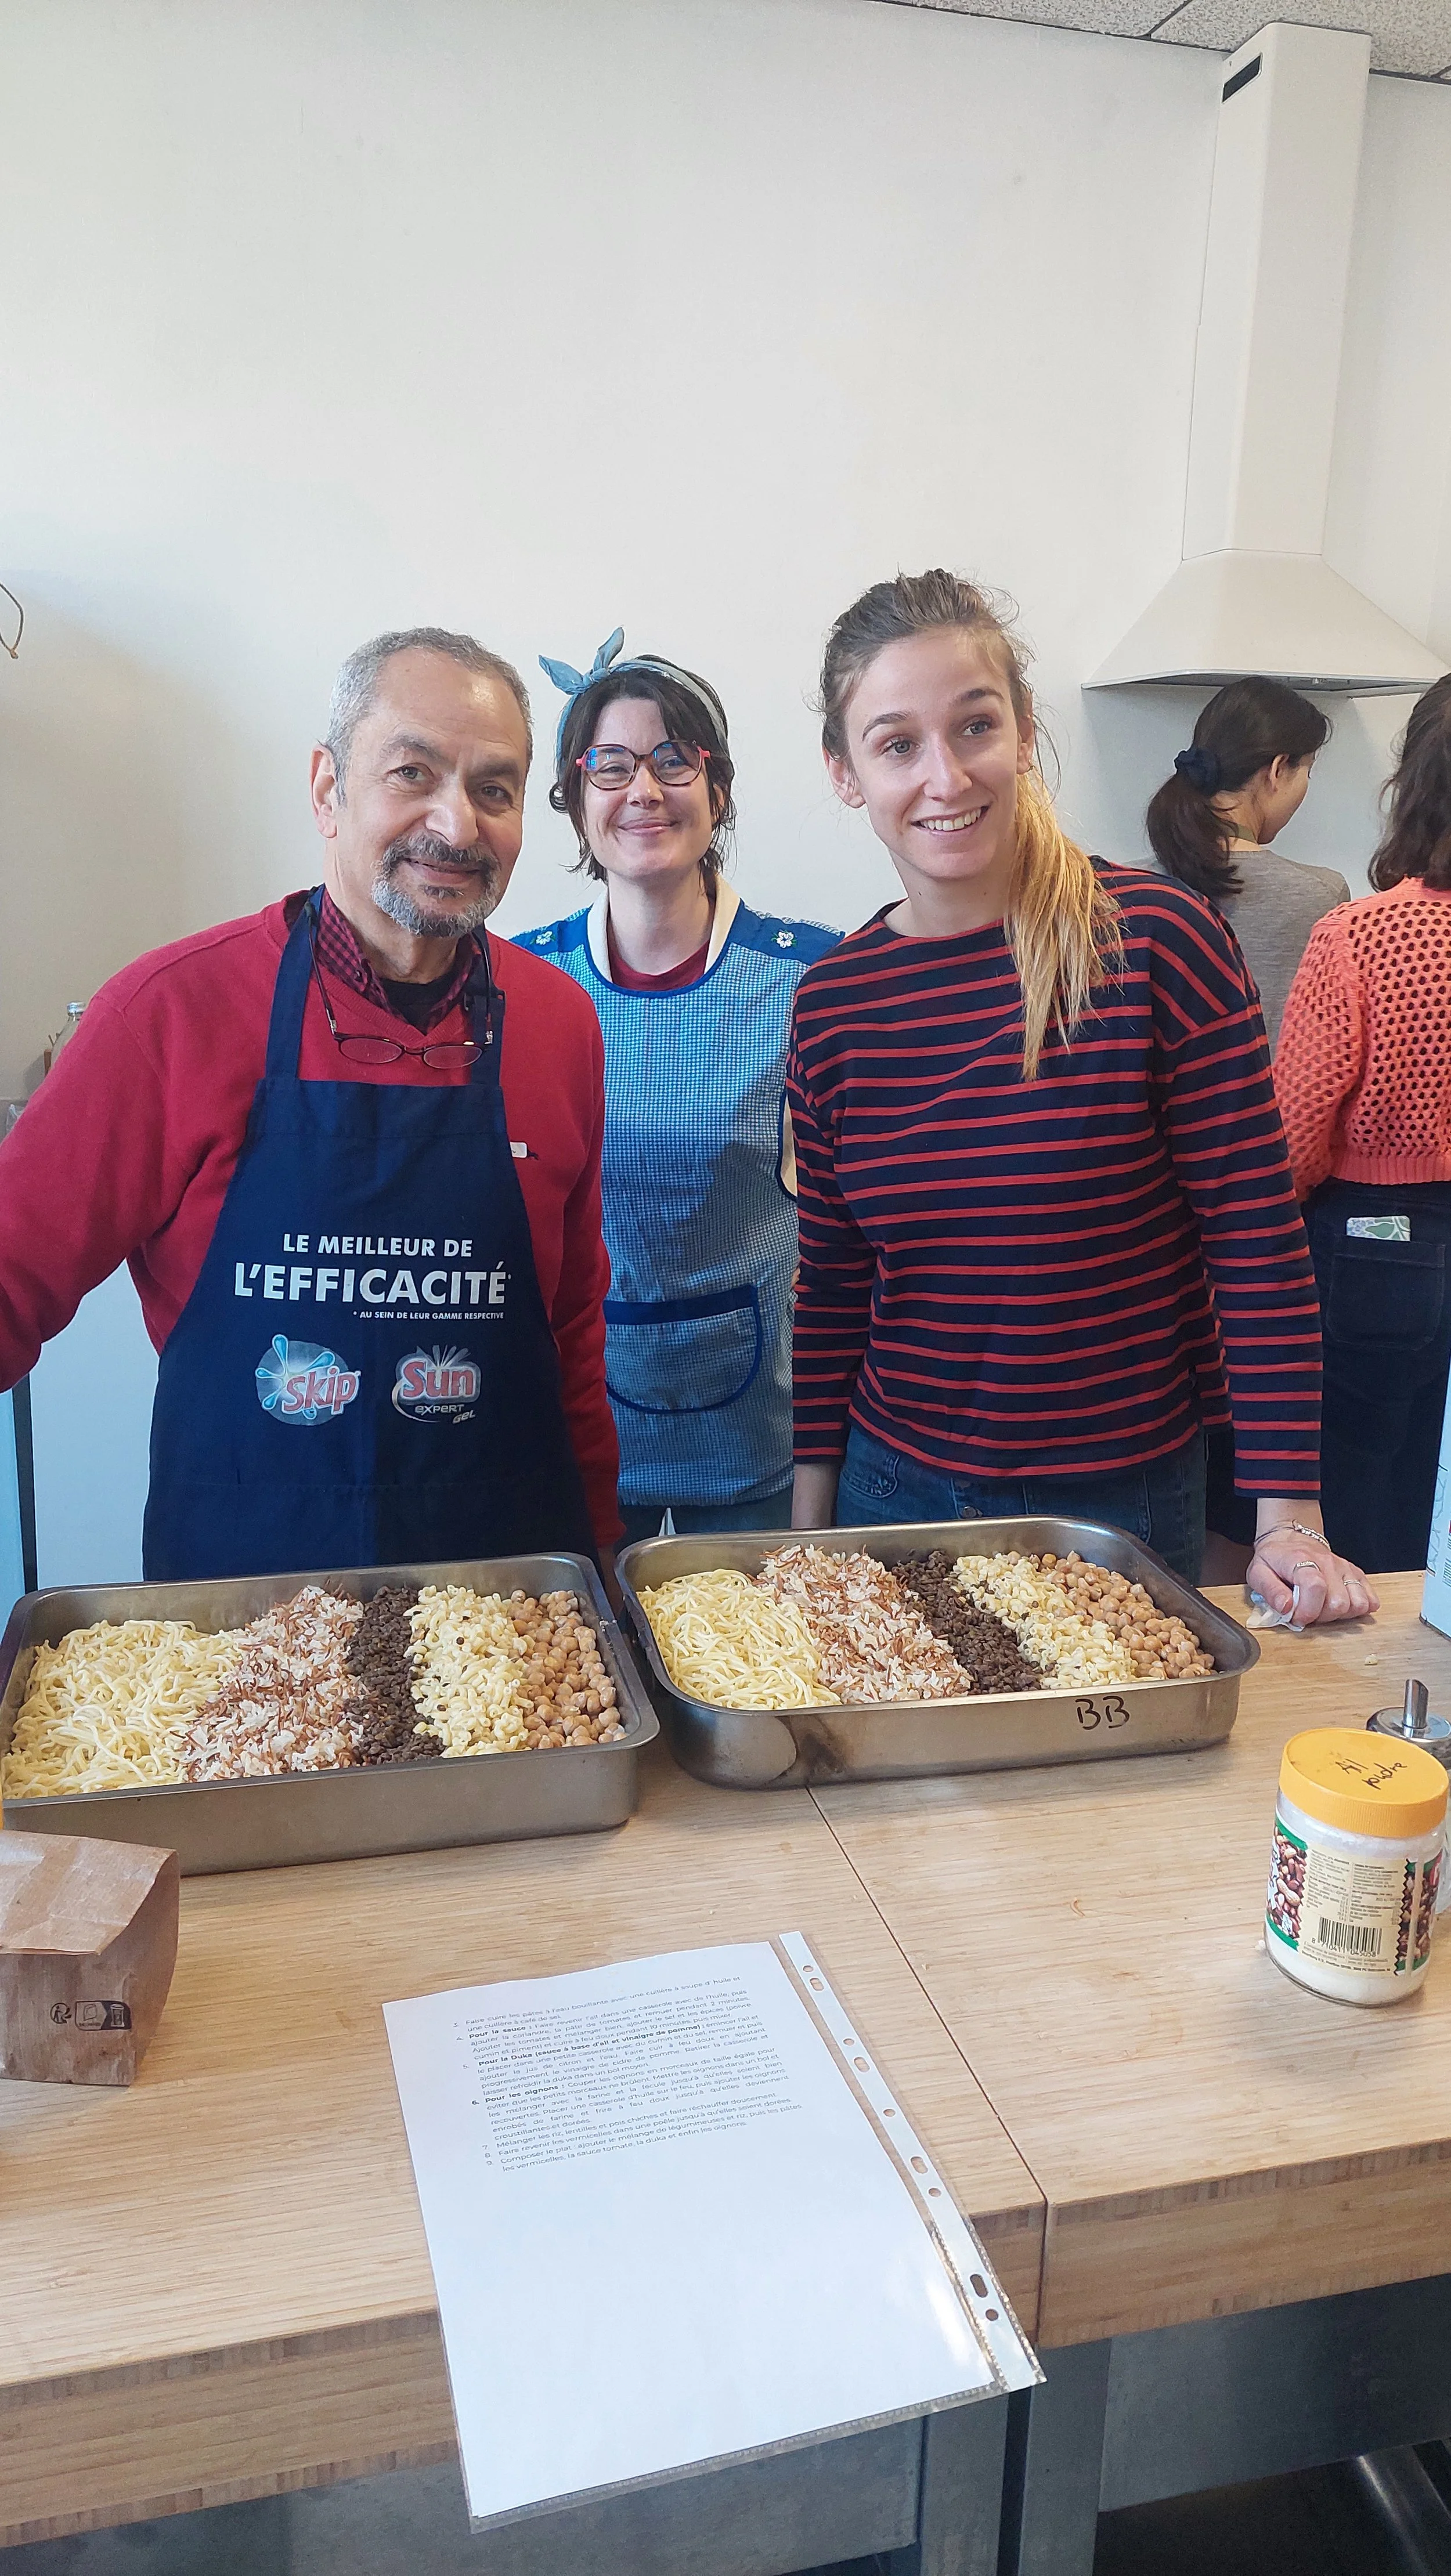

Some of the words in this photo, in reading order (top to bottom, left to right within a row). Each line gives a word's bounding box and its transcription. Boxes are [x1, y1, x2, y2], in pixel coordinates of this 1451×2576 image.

[283, 1234, 309, 1253] LE
[317, 1235, 435, 1257] MEILLEUR
[443, 1239, 472, 1258] DE
[283, 1367, 358, 1414] Skip
[403, 1361, 474, 1397] Sun
[622, 2033, 654, 2042] vinaigre
[667, 2024, 700, 2034] pomme)
[472, 2044, 501, 2053] Ajouter
[524, 2086, 558, 2095] oignons
[500, 2151, 544, 2163] Composer
[555, 2145, 572, 2154] plat
[577, 2140, 606, 2148] ajouter
